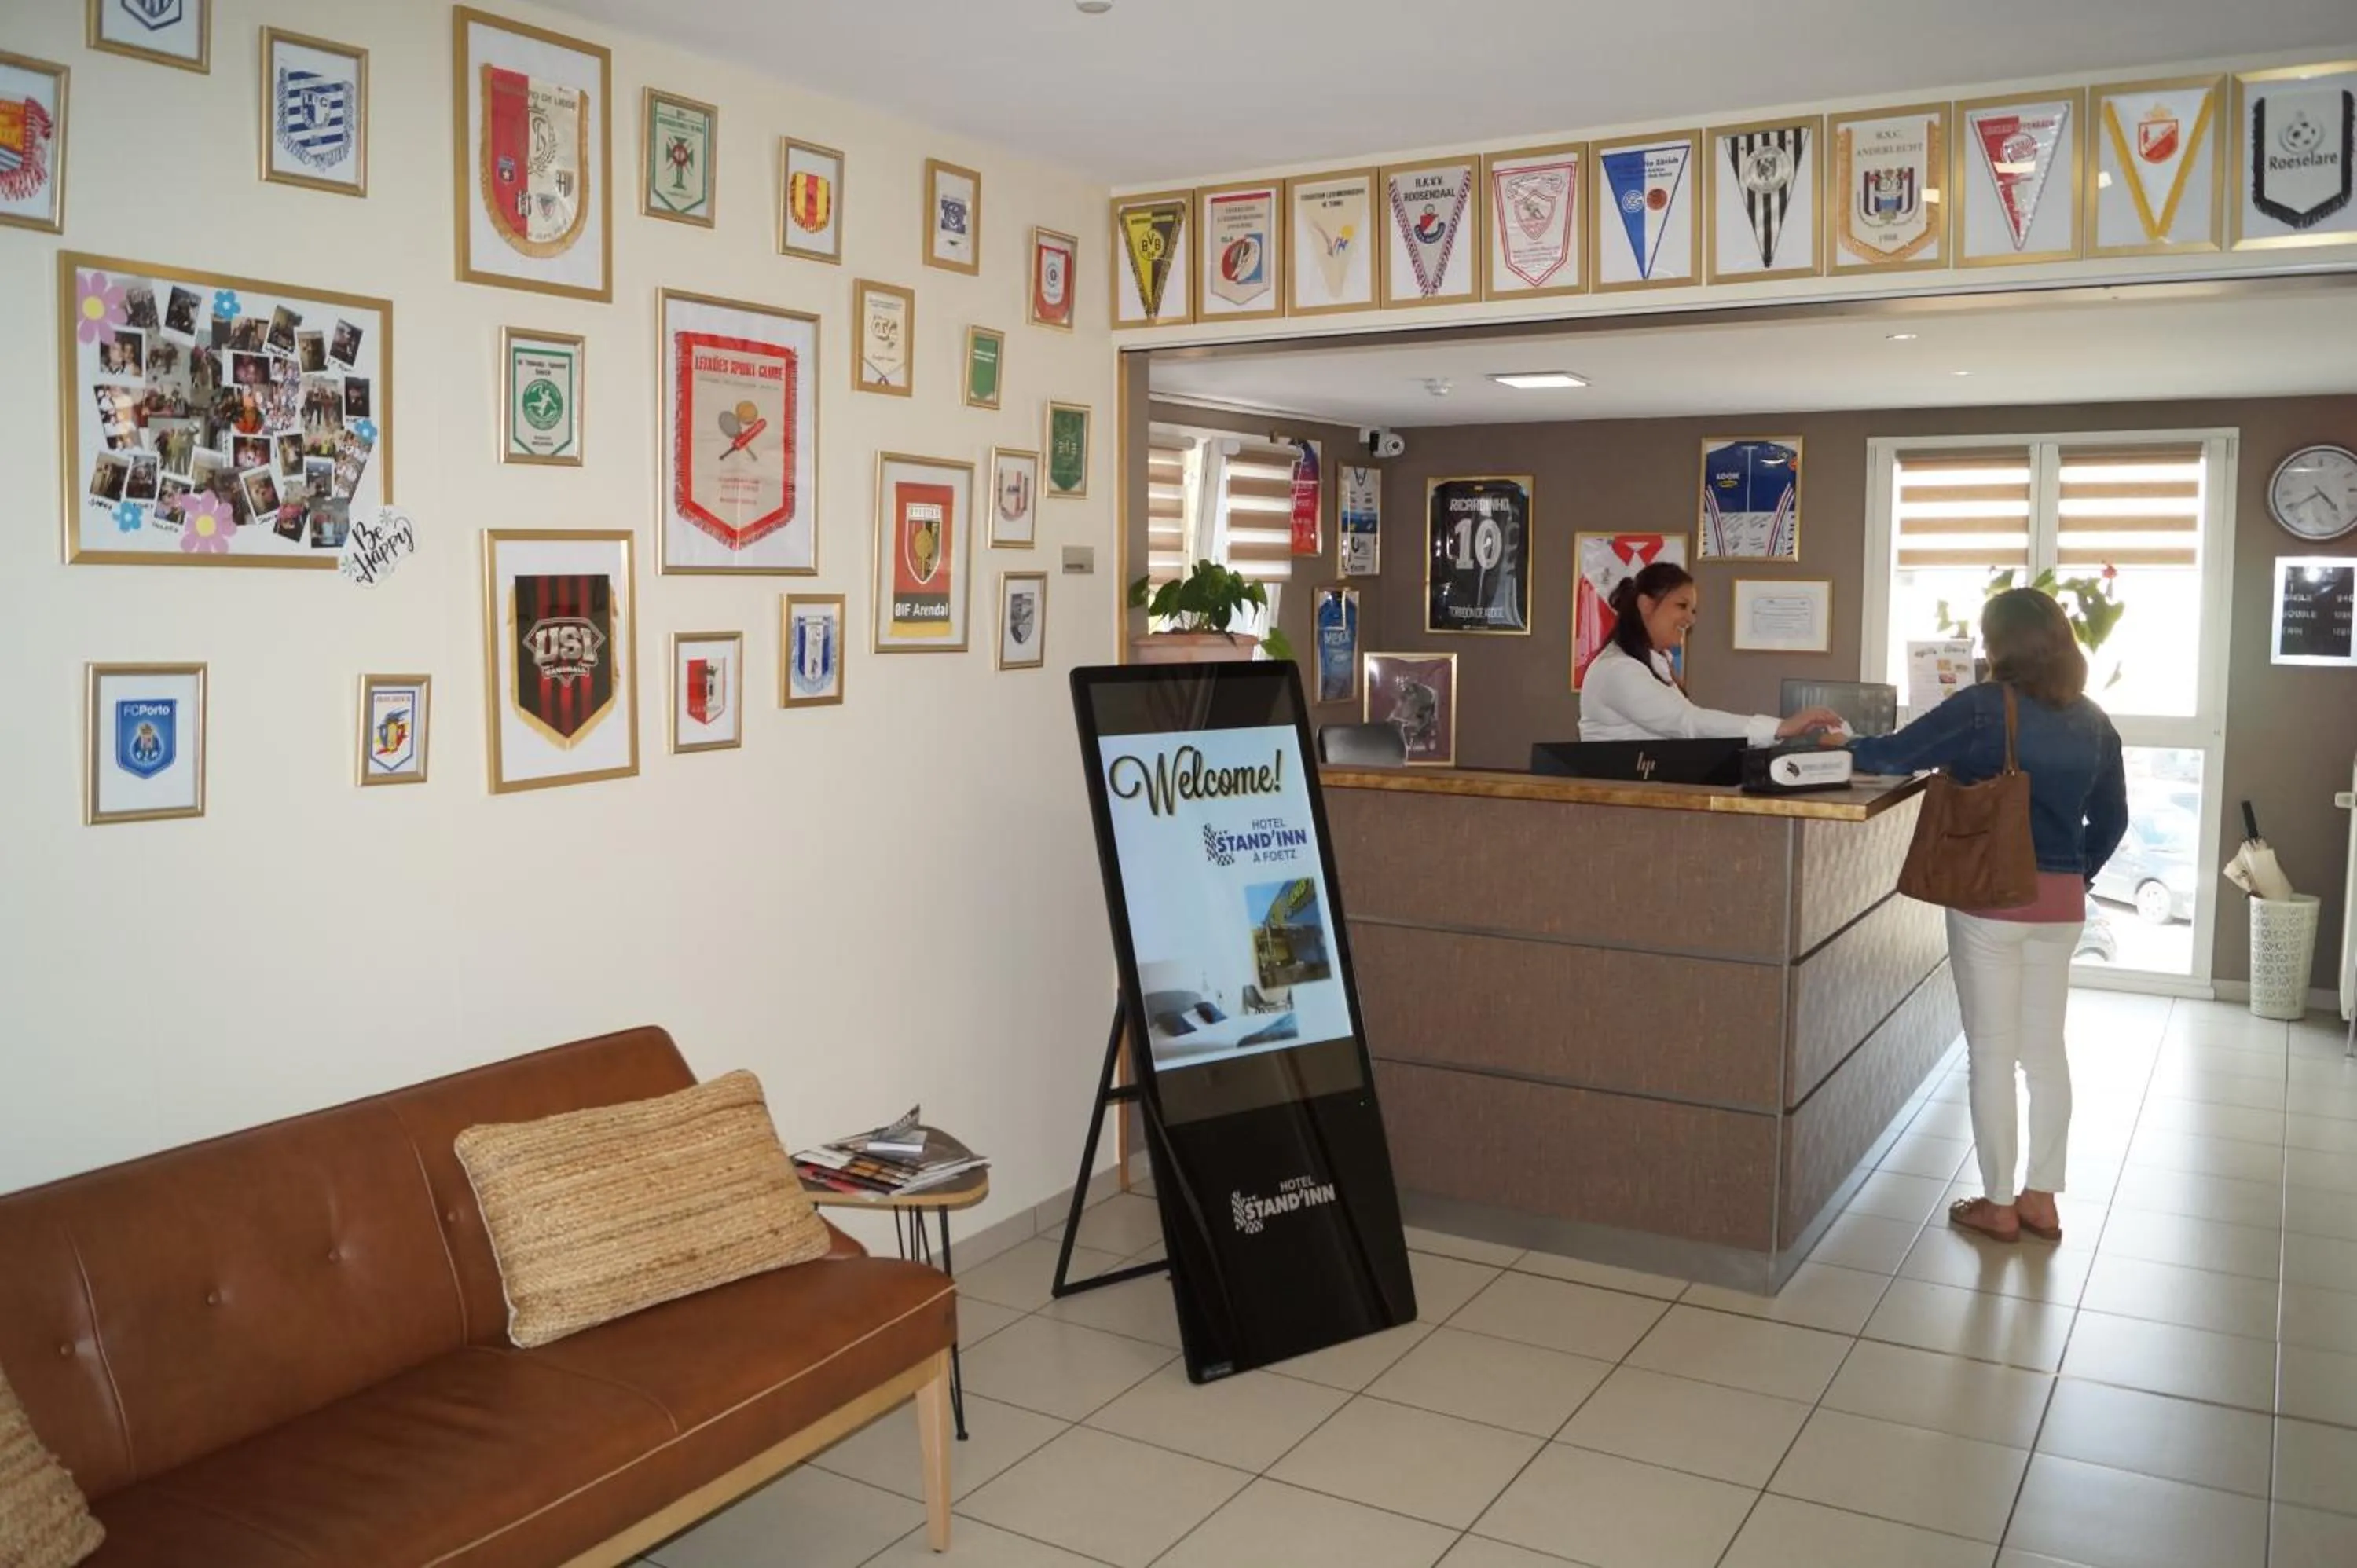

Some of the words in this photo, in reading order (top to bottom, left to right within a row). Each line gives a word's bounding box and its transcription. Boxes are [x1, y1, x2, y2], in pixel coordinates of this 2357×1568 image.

[2269, 150, 2338, 170] Roeselare
[1142, 231, 1161, 252] BVB
[351, 521, 384, 551] Be
[1454, 518, 1502, 570] 10
[355, 515, 414, 584] Happy
[912, 603, 948, 617] Arendal
[1637, 751, 1655, 780] hp
[1109, 745, 1282, 816] Welcome!
[1252, 818, 1287, 830] HOTEL
[1263, 848, 1298, 863] FOETZ
[1280, 1175, 1315, 1192] HOTEL
